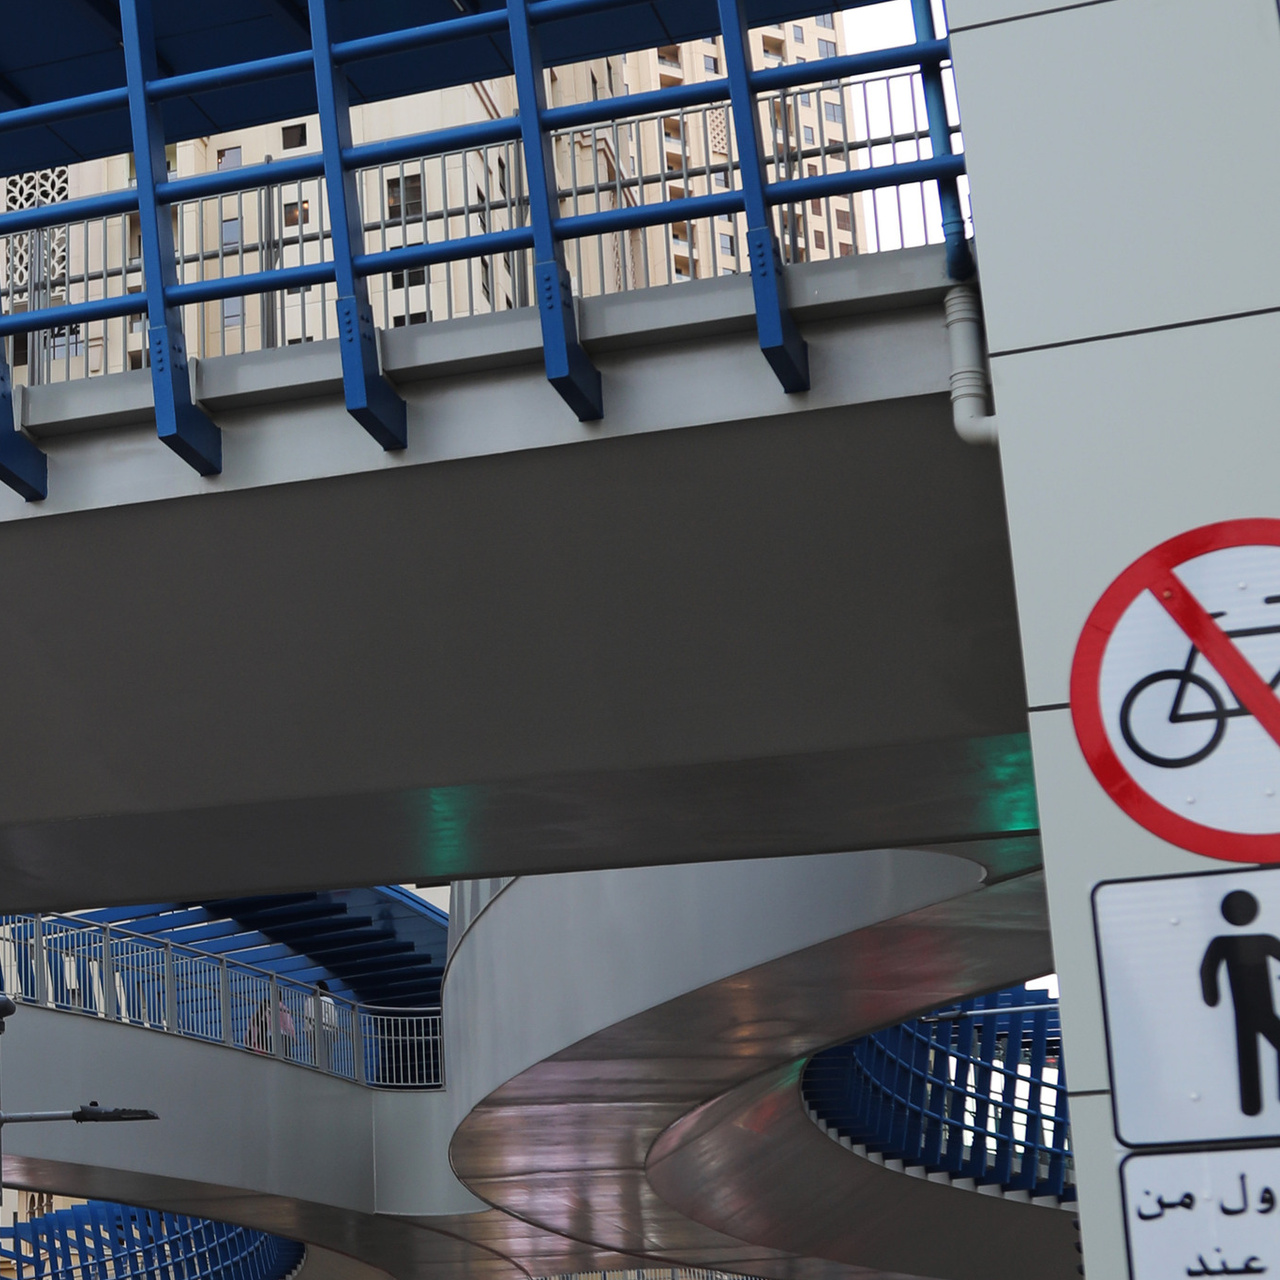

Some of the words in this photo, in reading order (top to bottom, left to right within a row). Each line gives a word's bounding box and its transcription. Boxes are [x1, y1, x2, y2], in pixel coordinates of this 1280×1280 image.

[1137, 1190, 1196, 1221] من
[1219, 1172, 1277, 1216] ول
[1186, 1247, 1269, 1277] عند
